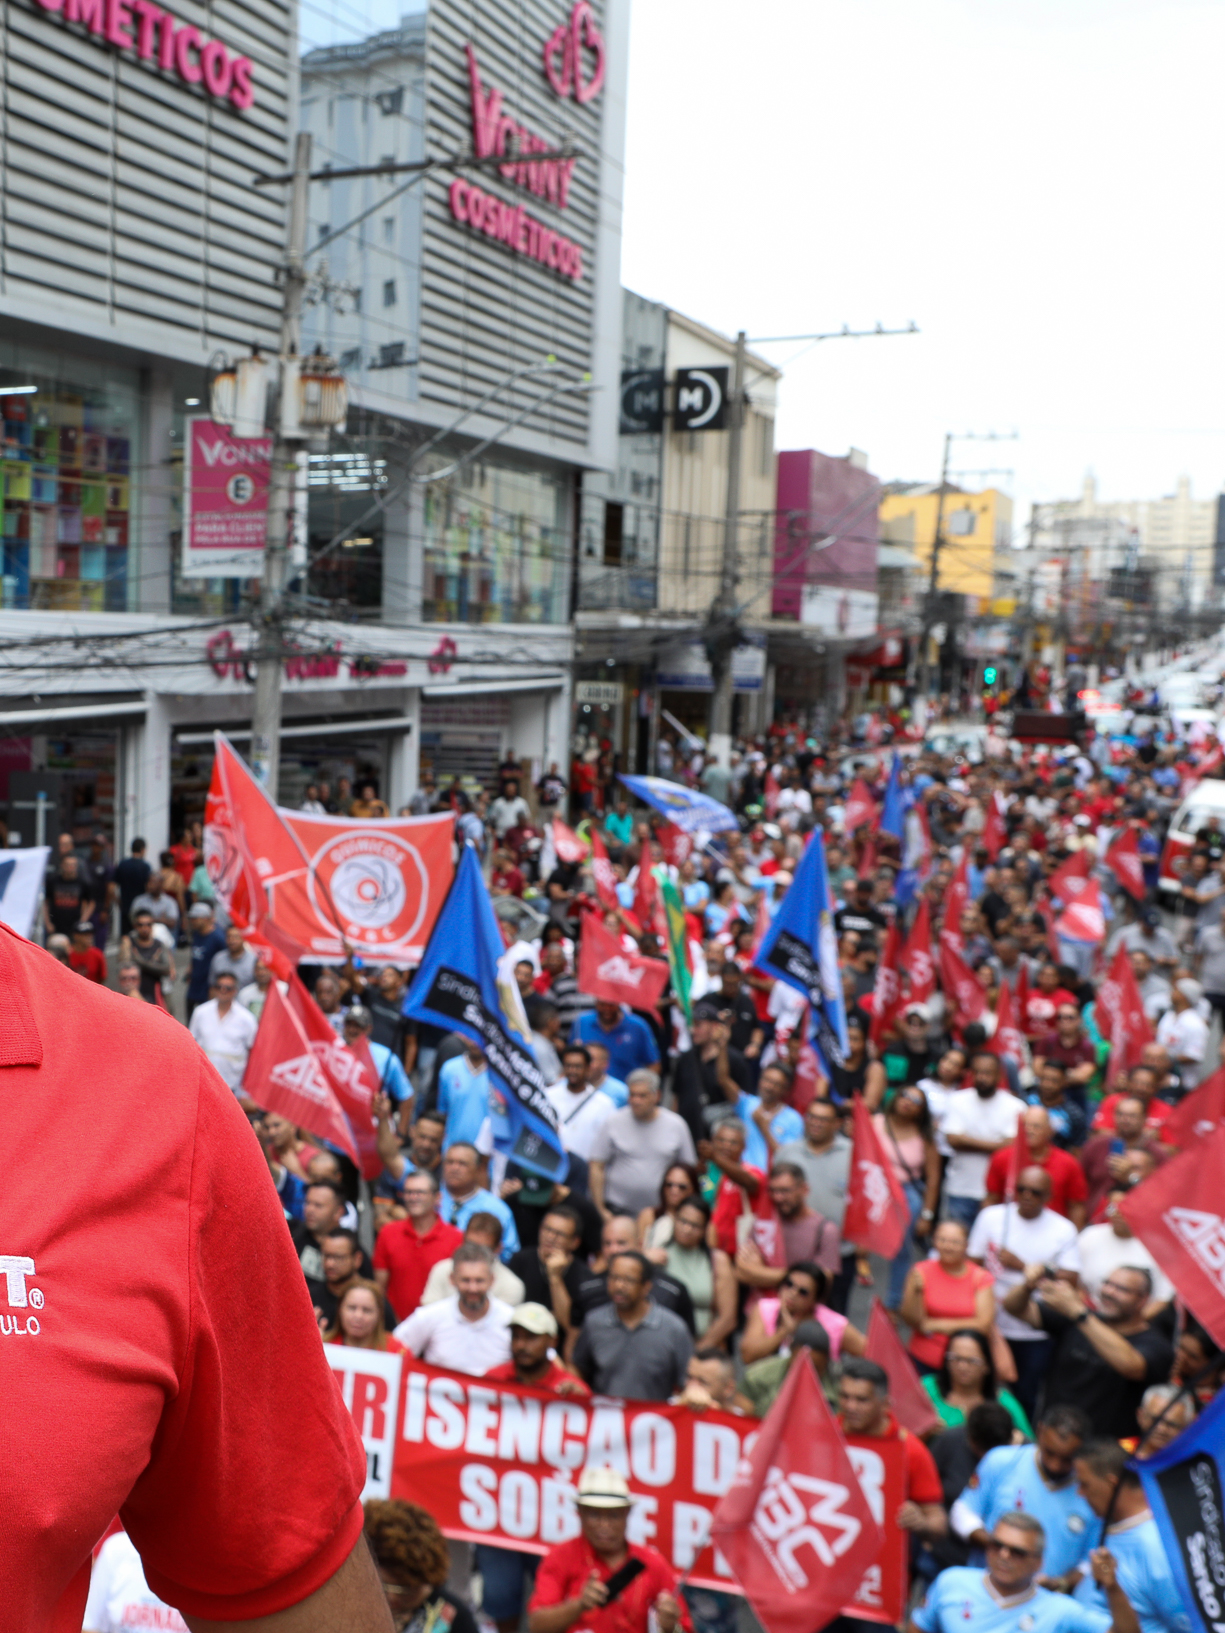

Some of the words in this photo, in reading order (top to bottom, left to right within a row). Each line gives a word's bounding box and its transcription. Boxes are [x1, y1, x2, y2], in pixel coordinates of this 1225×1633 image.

[35, 0, 254, 110] METICOS
[402, 1371, 677, 1487] ISENÇÃO
[459, 1462, 657, 1546] SOBE
